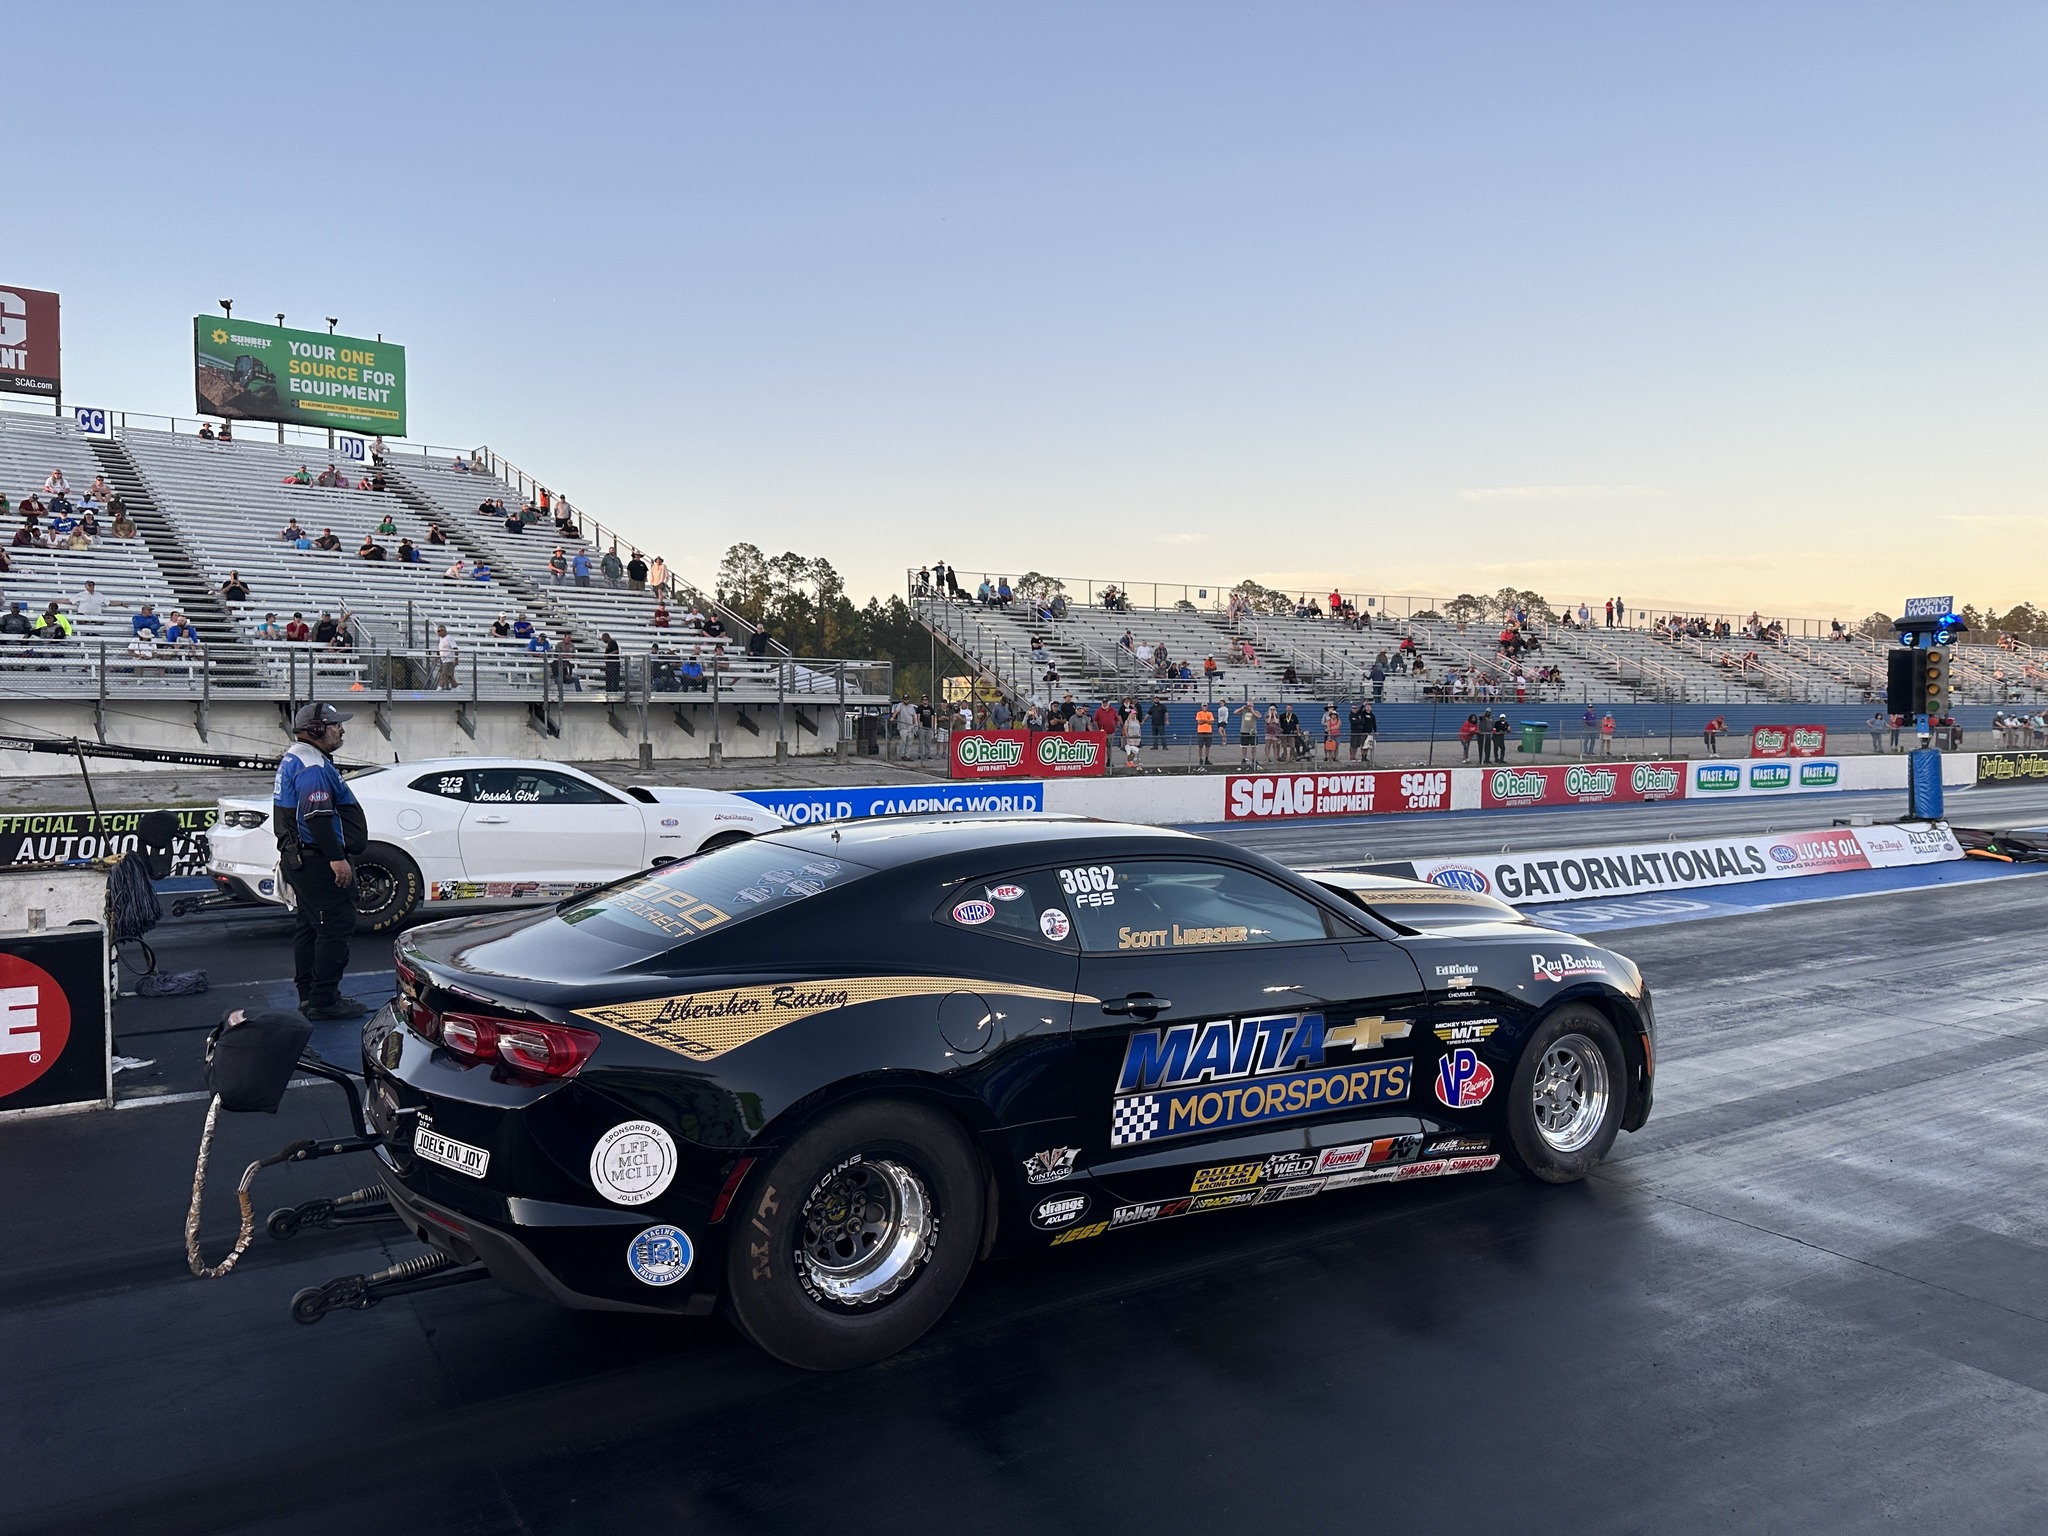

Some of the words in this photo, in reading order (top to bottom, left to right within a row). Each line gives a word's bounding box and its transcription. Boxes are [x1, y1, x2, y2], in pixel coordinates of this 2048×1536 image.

[231, 334, 272, 347] SUNBELT
[0, 347, 27, 370] NT
[288, 341, 336, 361] YOUR
[340, 349, 375, 367] ONE
[289, 359, 358, 382] SOURCE
[363, 370, 396, 387] FOR
[15, 377, 53, 390] SCAG.com
[289, 377, 390, 403] EQUIPMENT
[77, 409, 103, 431] CC
[341, 437, 363, 459] DD
[1907, 605, 1950, 616] WORLD
[1908, 597, 1950, 607] CAMPING
[960, 737, 1021, 765] O'Reilly
[1039, 738, 1097, 766] O'Reilly
[1633, 766, 1679, 793] O'Reilly
[1700, 770, 1723, 781] WASTE
[1724, 769, 1738, 781] PRO
[1753, 769, 1774, 780] WASTE
[1776, 768, 1788, 779] PRO
[1803, 767, 1822, 778] WASTE
[1824, 767, 1836, 777] PRO
[438, 777, 464, 787] 313
[1401, 773, 1446, 796] SCAG
[1493, 770, 1545, 798] O'Reilly
[1566, 768, 1615, 796] O'Reilly
[474, 789, 512, 801] Jesse's
[514, 790, 540, 801] Girl
[1231, 777, 1314, 816] SCAG
[1318, 776, 1375, 794] POWER
[1317, 794, 1374, 813] EQUIPMENT
[1406, 795, 1440, 809] .COM
[769, 801, 852, 824] WORLD
[870, 797, 962, 816] CAMPING
[966, 795, 1036, 813] WORLD
[1772, 847, 1796, 861] NHRA
[1796, 840, 1837, 861] LUCAS
[1838, 838, 1862, 856] OIL
[1914, 844, 1940, 854] CALLOUT
[1432, 864, 1473, 875] CHAMPIONSHIP
[1495, 845, 1767, 898] GATORNATIONALS
[1777, 862, 1802, 871] DRAG
[1805, 859, 1837, 868] RACING
[1059, 865, 1118, 895] 3662
[1434, 870, 1483, 892] NHRA
[997, 887, 1018, 896] RFC
[1076, 892, 1115, 909] FSS
[960, 905, 989, 920] NHRA
[1435, 966, 1449, 975] Ed
[1449, 964, 1479, 975] Rinke
[1531, 954, 1563, 982] Ray
[1561, 954, 1605, 969] Barton
[651, 992, 761, 1024] Libersher
[771, 986, 848, 1009] Racing
[1435, 1021, 1460, 1029] MICKEY
[1461, 1018, 1498, 1027] THOMPSON
[1451, 1026, 1484, 1040] M/T
[1114, 1012, 1327, 1094] MAITA
[1439, 1048, 1477, 1107] VP
[1462, 1077, 1492, 1099] Racing
[1168, 1066, 1405, 1130] MOTORSPORTS
[417, 1111, 433, 1122] PUSH
[418, 1120, 430, 1128] OFF
[605, 1125, 650, 1144] SPONSORED
[651, 1128, 662, 1137] BY
[418, 1133, 445, 1155] JOEL'S
[447, 1144, 461, 1161] ON
[462, 1150, 483, 1168] JOY
[620, 1140, 649, 1155] LFP
[618, 1154, 649, 1168] MCI
[1274, 1160, 1314, 1174] WELD
[1449, 1158, 1496, 1171] SIMPSON
[611, 1167, 642, 1182] MCI
[1030, 1167, 1070, 1182] VINTAGE
[1195, 1163, 1263, 1183] BULLET
[1278, 1170, 1308, 1178] RACING
[1349, 1172, 1394, 1184] PERFORMANCE
[1400, 1163, 1443, 1177] SIMPSON
[802, 1154, 862, 1216] RACING
[1198, 1179, 1228, 1190] RACING
[1229, 1178, 1251, 1186] CAMS
[617, 1193, 645, 1202] JOLIET,
[646, 1190, 654, 1198] IL
[1204, 1192, 1256, 1208] RACEPAK
[1039, 1199, 1084, 1217] Strange
[1113, 1206, 1161, 1225] Holley
[1159, 1201, 1189, 1215] EFI
[1044, 1212, 1076, 1226] AXLES
[643, 1228, 675, 1240] RACING
[923, 1218, 940, 1263] USA
[1049, 1221, 1110, 1246] JEGS
[638, 1266, 658, 1282] VALVE
[659, 1263, 686, 1282] SPRINGS
[793, 1250, 823, 1302] WELD
